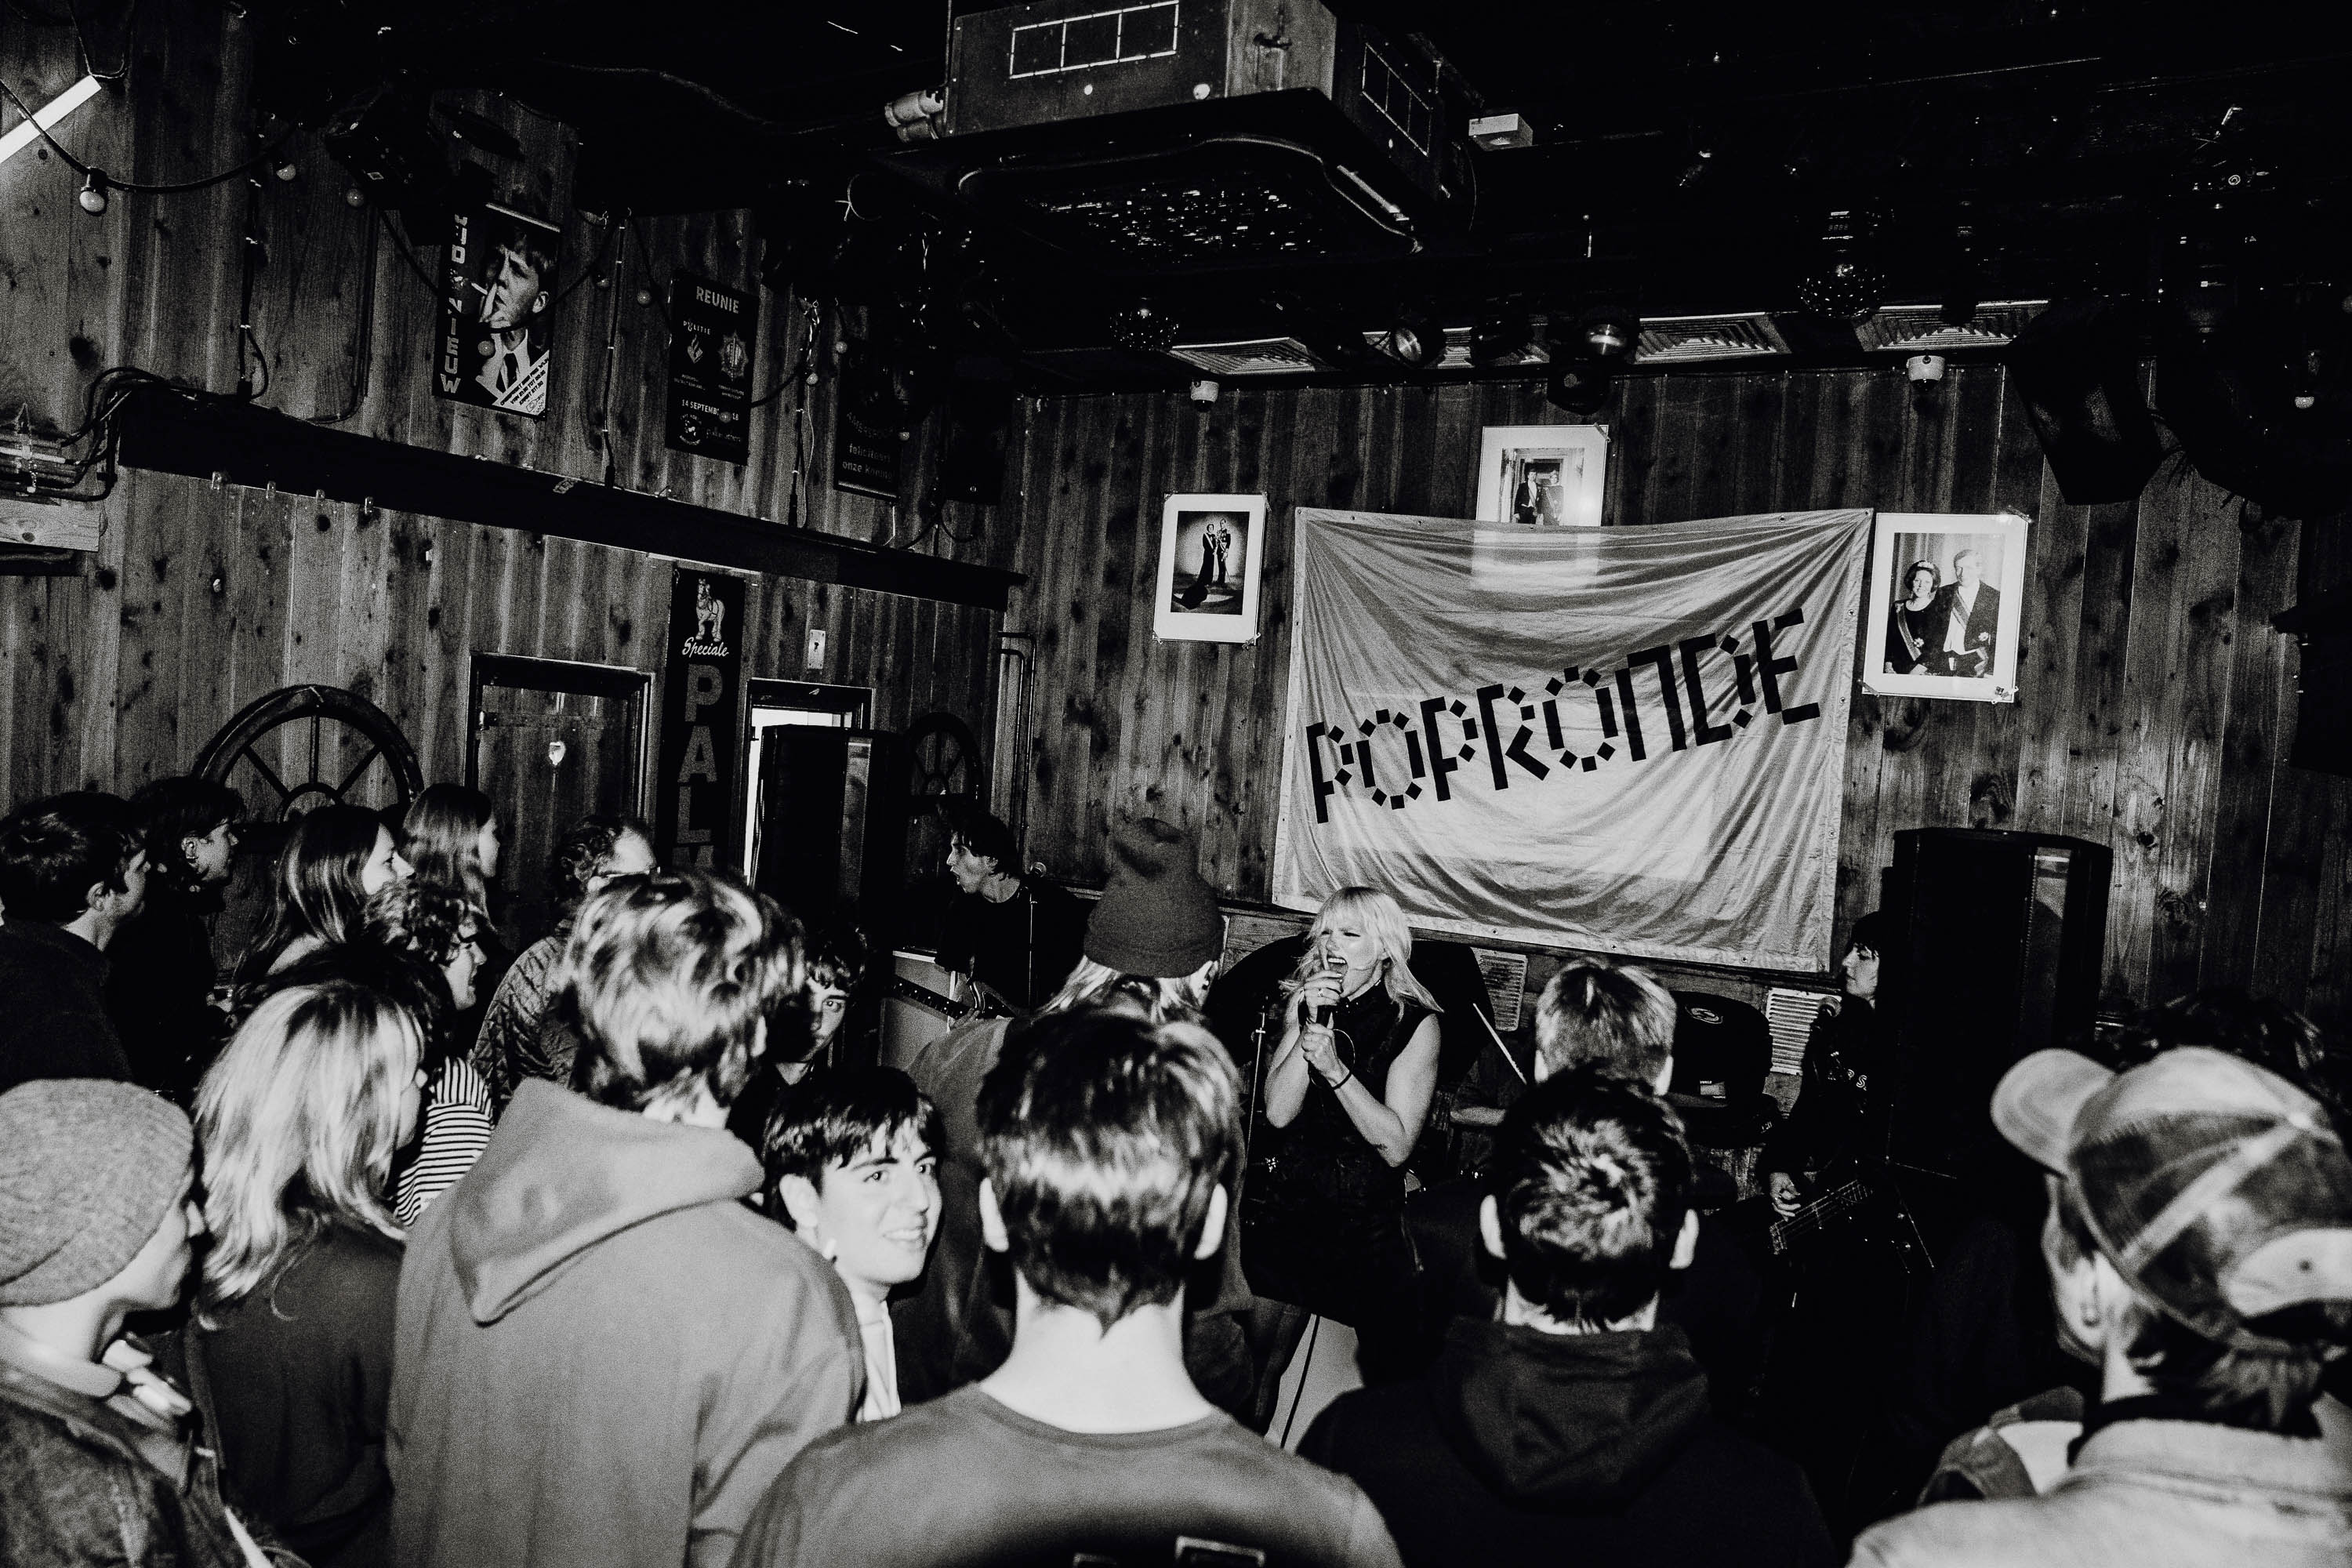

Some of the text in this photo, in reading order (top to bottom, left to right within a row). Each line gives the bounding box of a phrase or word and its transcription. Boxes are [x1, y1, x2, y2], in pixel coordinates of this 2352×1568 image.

[695, 285, 740, 314] REUNIE
[439, 296, 463, 394] NIEUW
[681, 398, 690, 407] 14
[690, 401, 720, 416] SEPTEMB
[681, 636, 730, 659] Speciale
